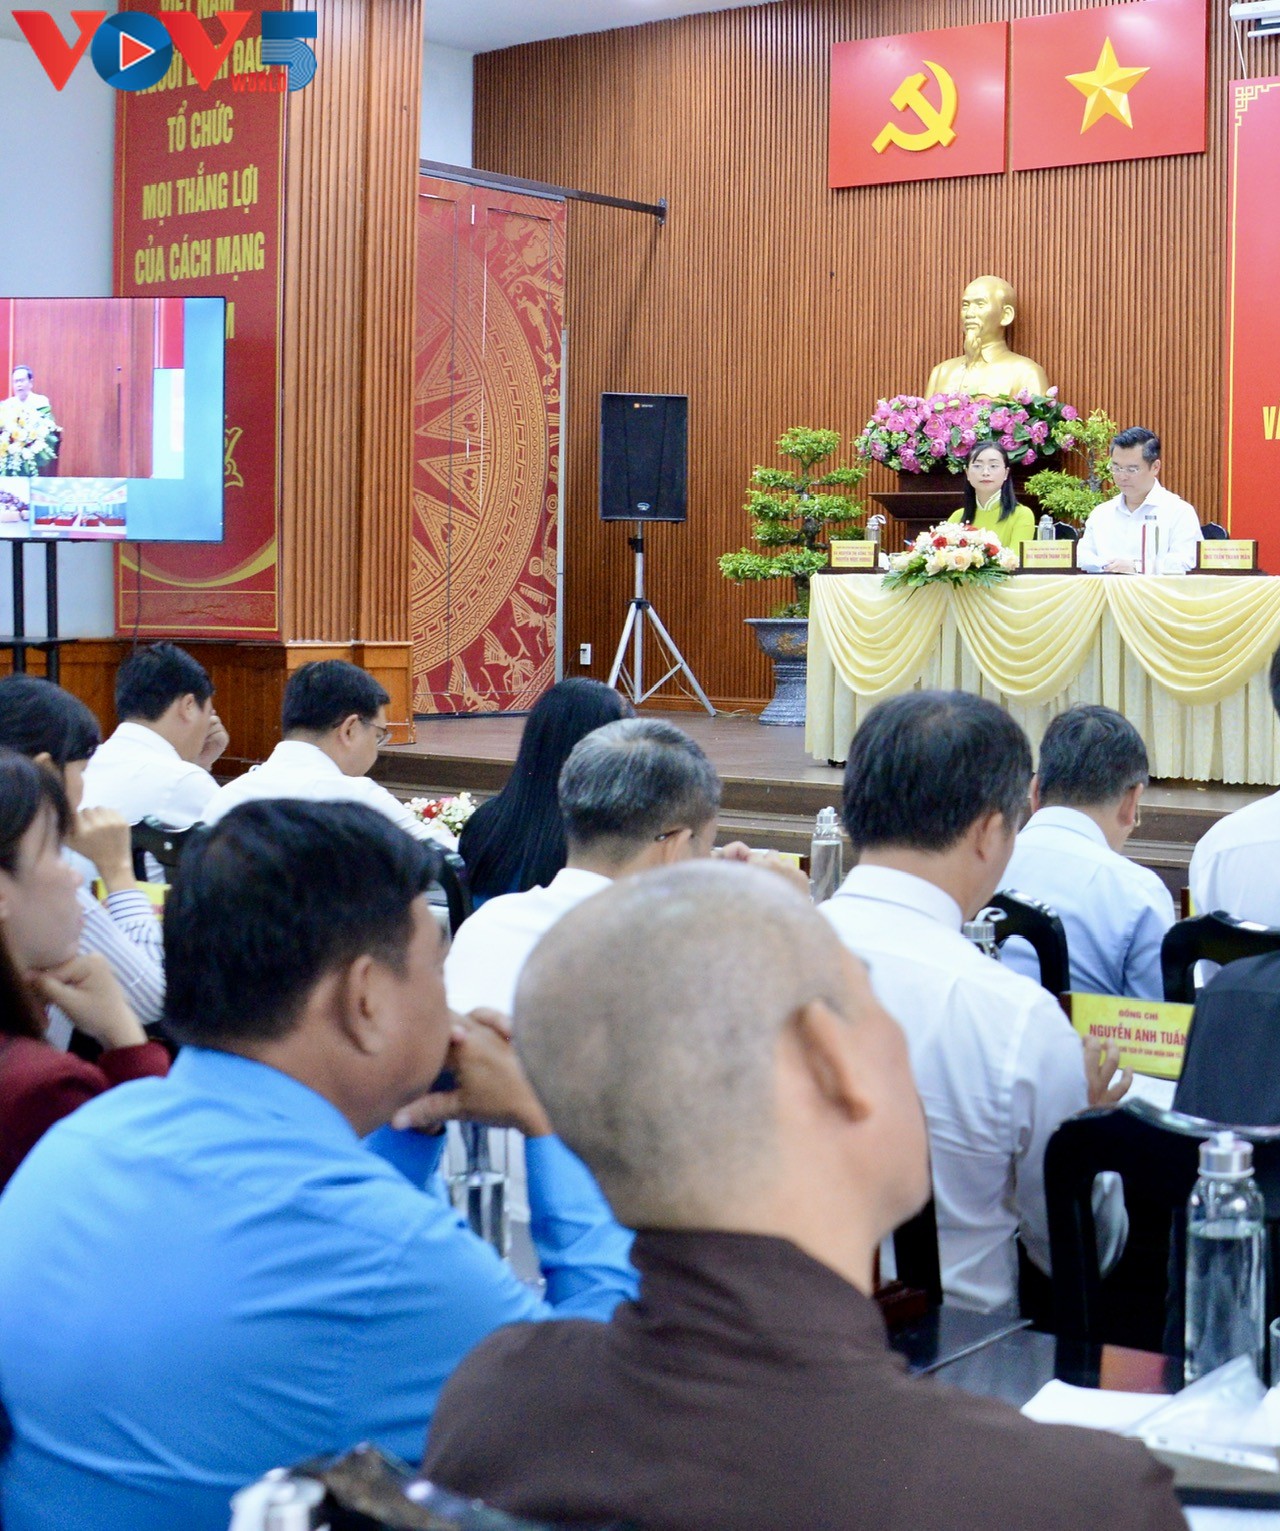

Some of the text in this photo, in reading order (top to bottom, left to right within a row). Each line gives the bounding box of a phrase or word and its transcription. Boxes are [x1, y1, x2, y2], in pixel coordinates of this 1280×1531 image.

[167, 100, 234, 153] TỔ CHỨC
[142, 162, 258, 226] MỌI THẮNG LỢI
[135, 231, 265, 285] CỦA CÁCH MẠNG
[1089, 1022, 1132, 1040] NGUYỄN
[1134, 1029, 1157, 1043] ANH
